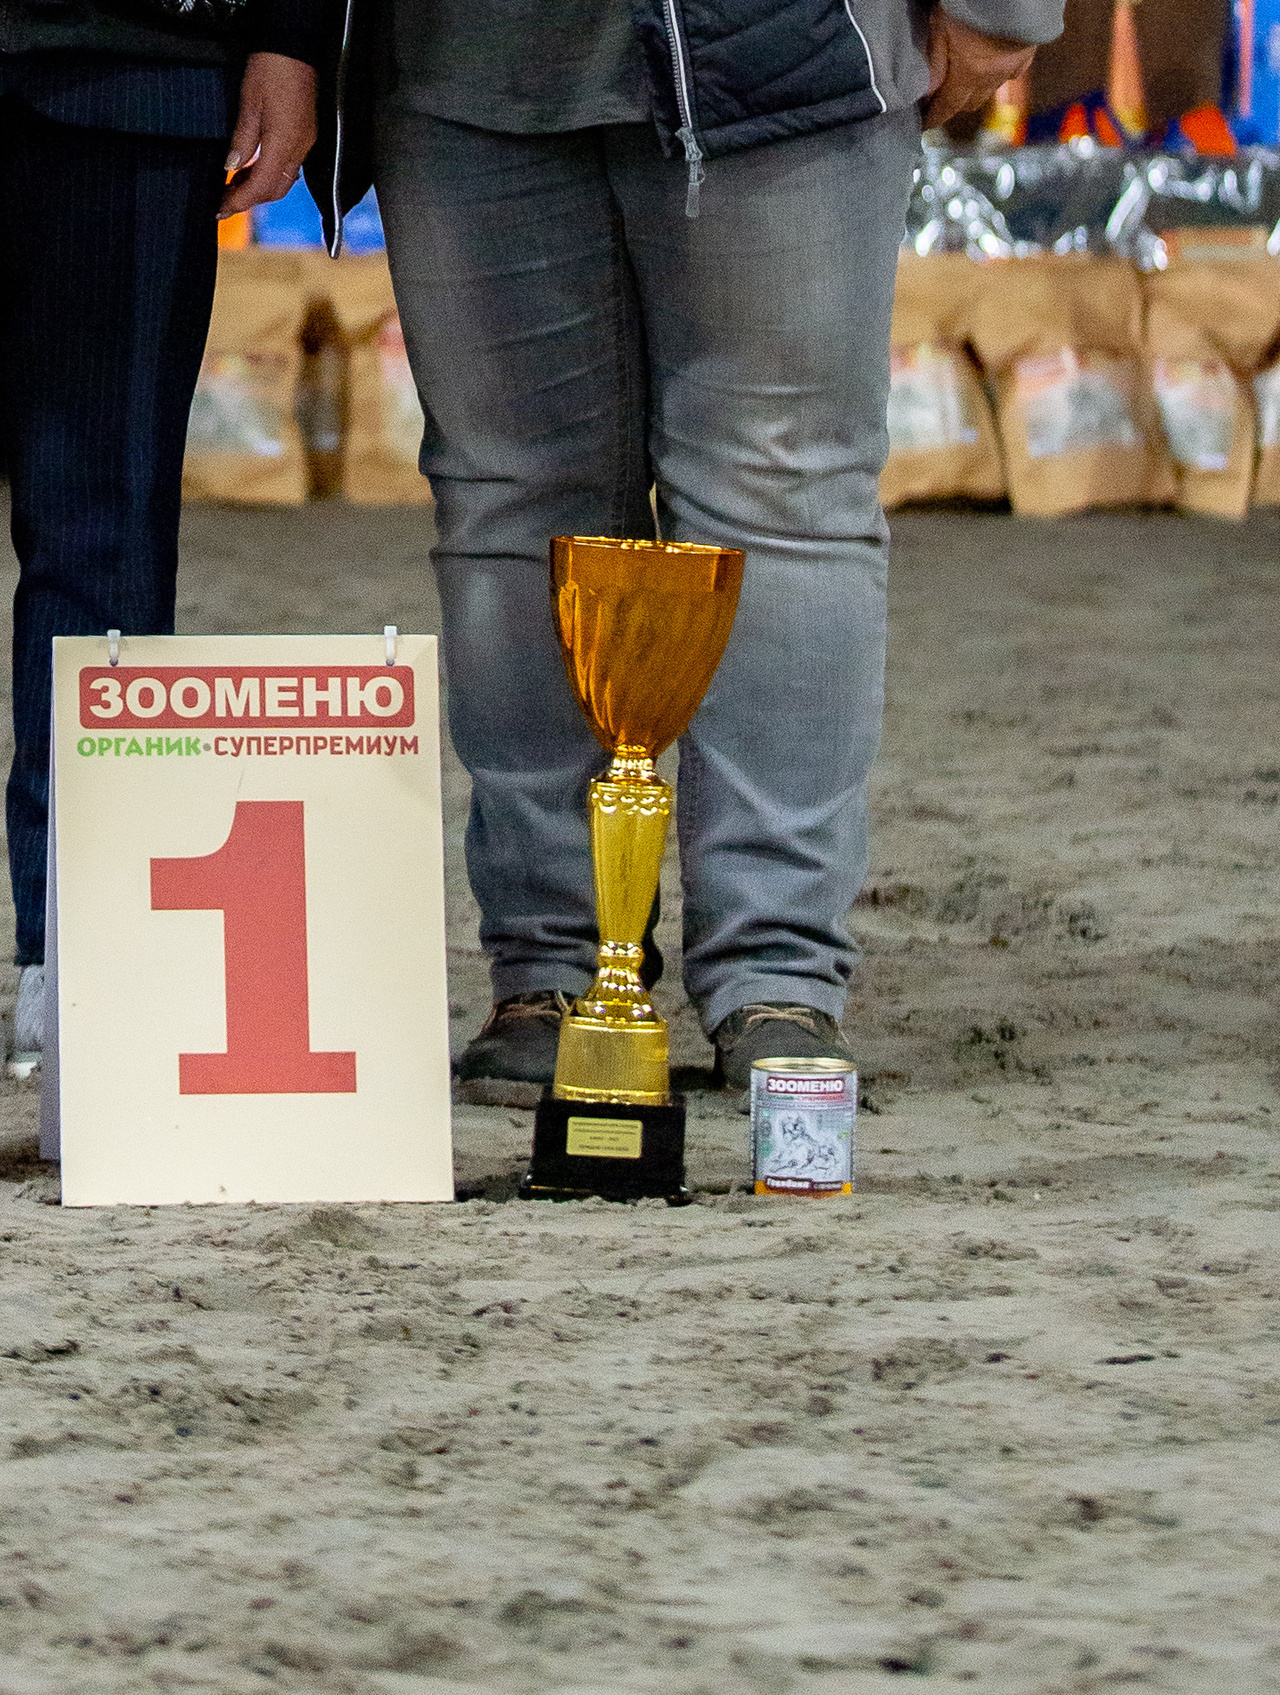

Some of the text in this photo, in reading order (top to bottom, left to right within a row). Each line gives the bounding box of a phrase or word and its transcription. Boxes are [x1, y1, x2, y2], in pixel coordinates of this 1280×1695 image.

[89, 676, 404, 719] ЗООМЕНЮ
[77, 735, 419, 758] ОРГАНИК СУПЕРПРЕМИУМ
[150, 800, 357, 1095] 1
[768, 1078, 843, 1093] ЗООМЕНЮ
